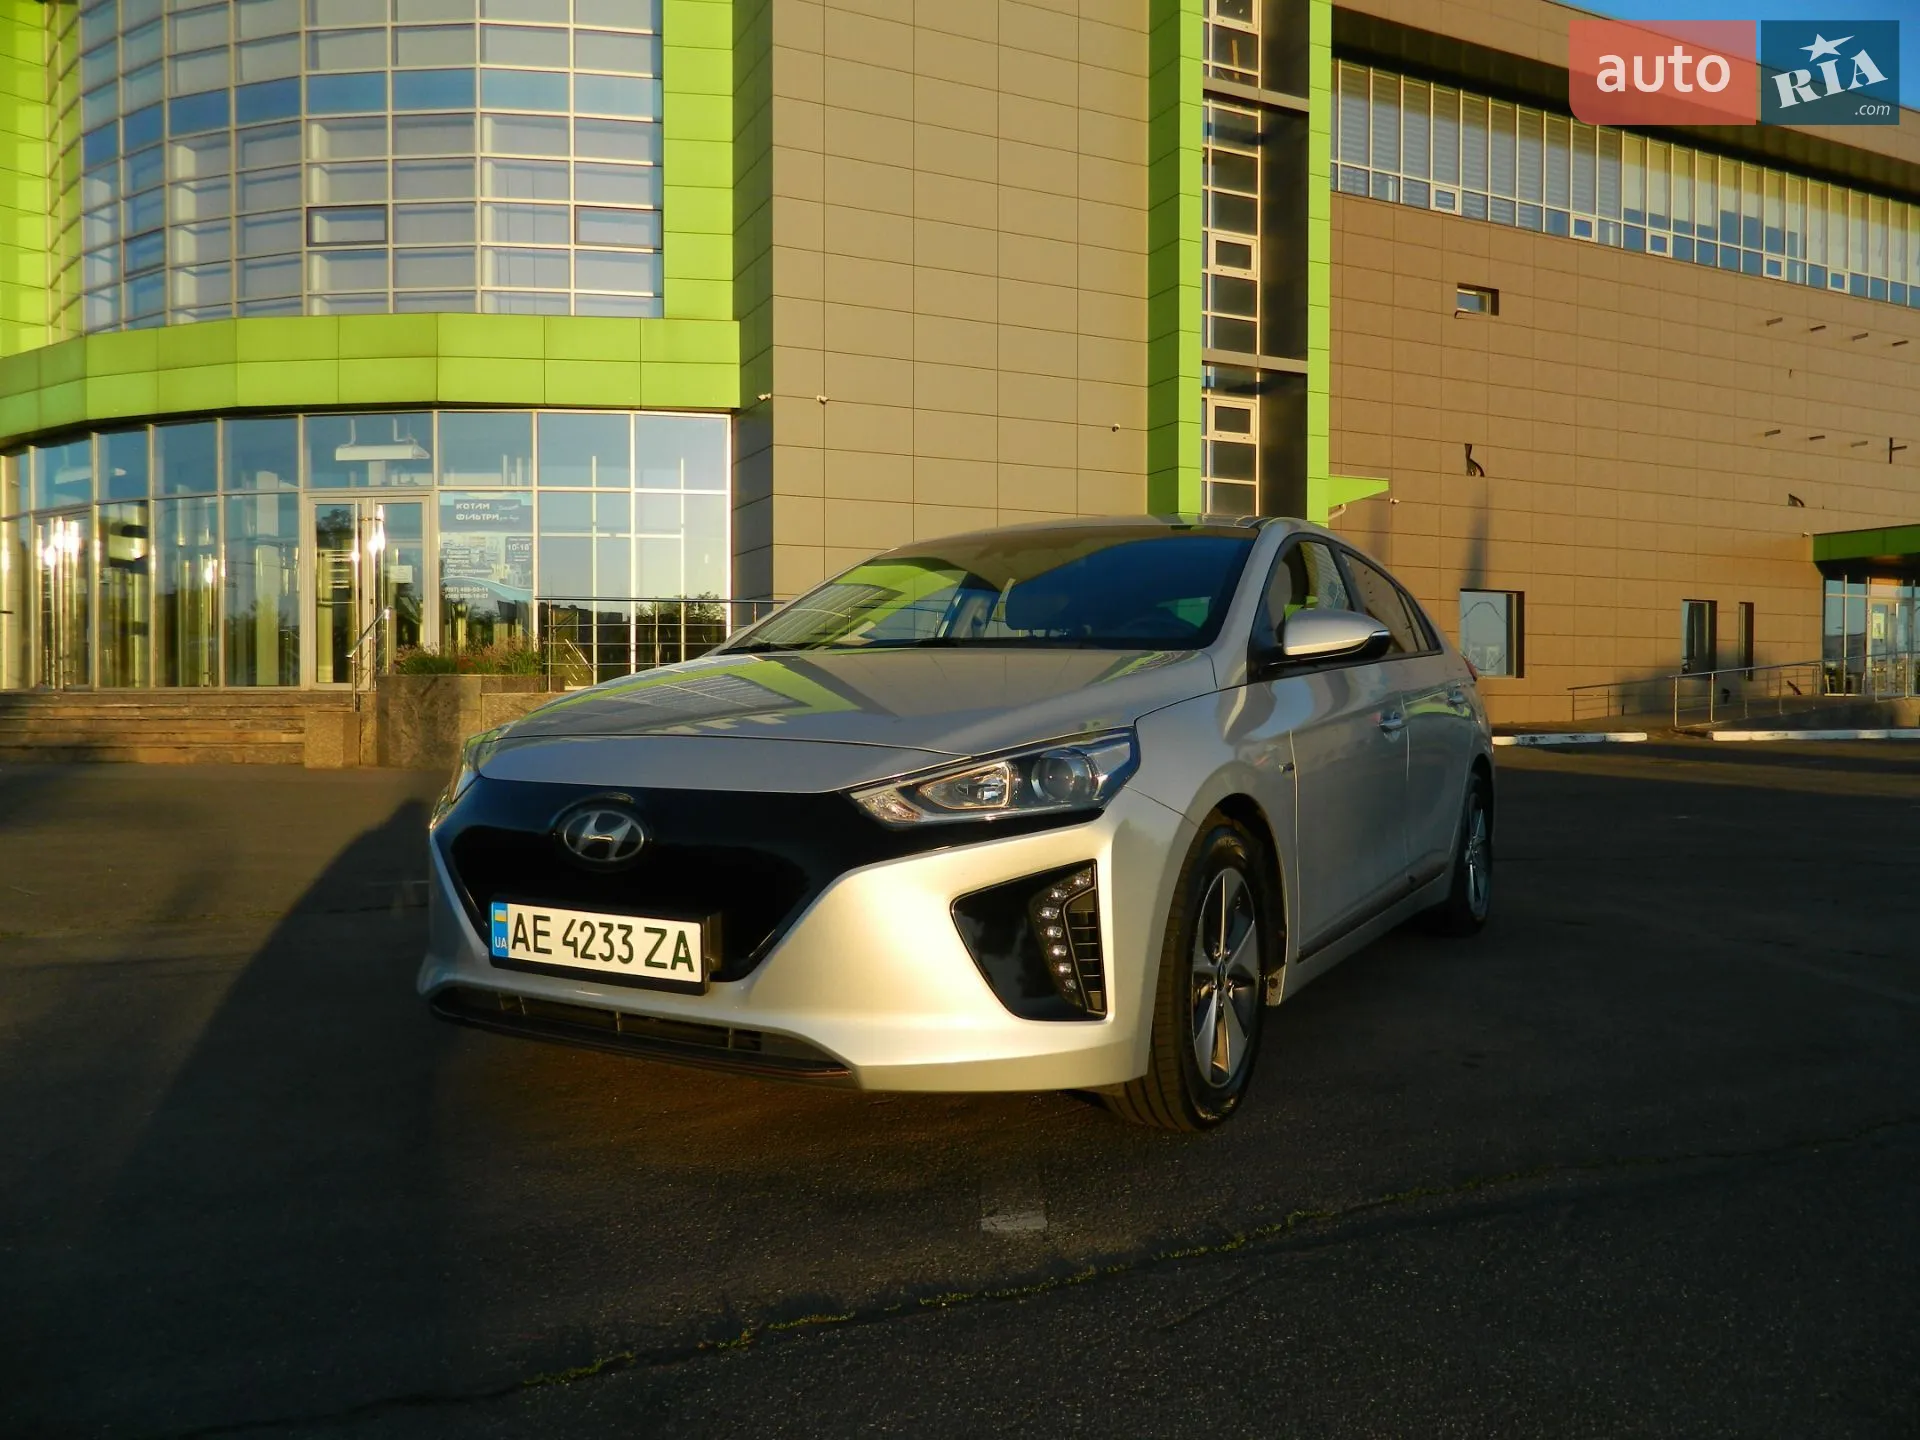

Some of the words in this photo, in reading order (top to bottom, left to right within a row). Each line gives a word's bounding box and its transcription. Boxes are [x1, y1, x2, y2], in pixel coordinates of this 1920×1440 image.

[494, 936, 508, 948] UA
[511, 912, 552, 955] AE
[562, 918, 634, 965] 4233
[644, 926, 695, 972] ZA
